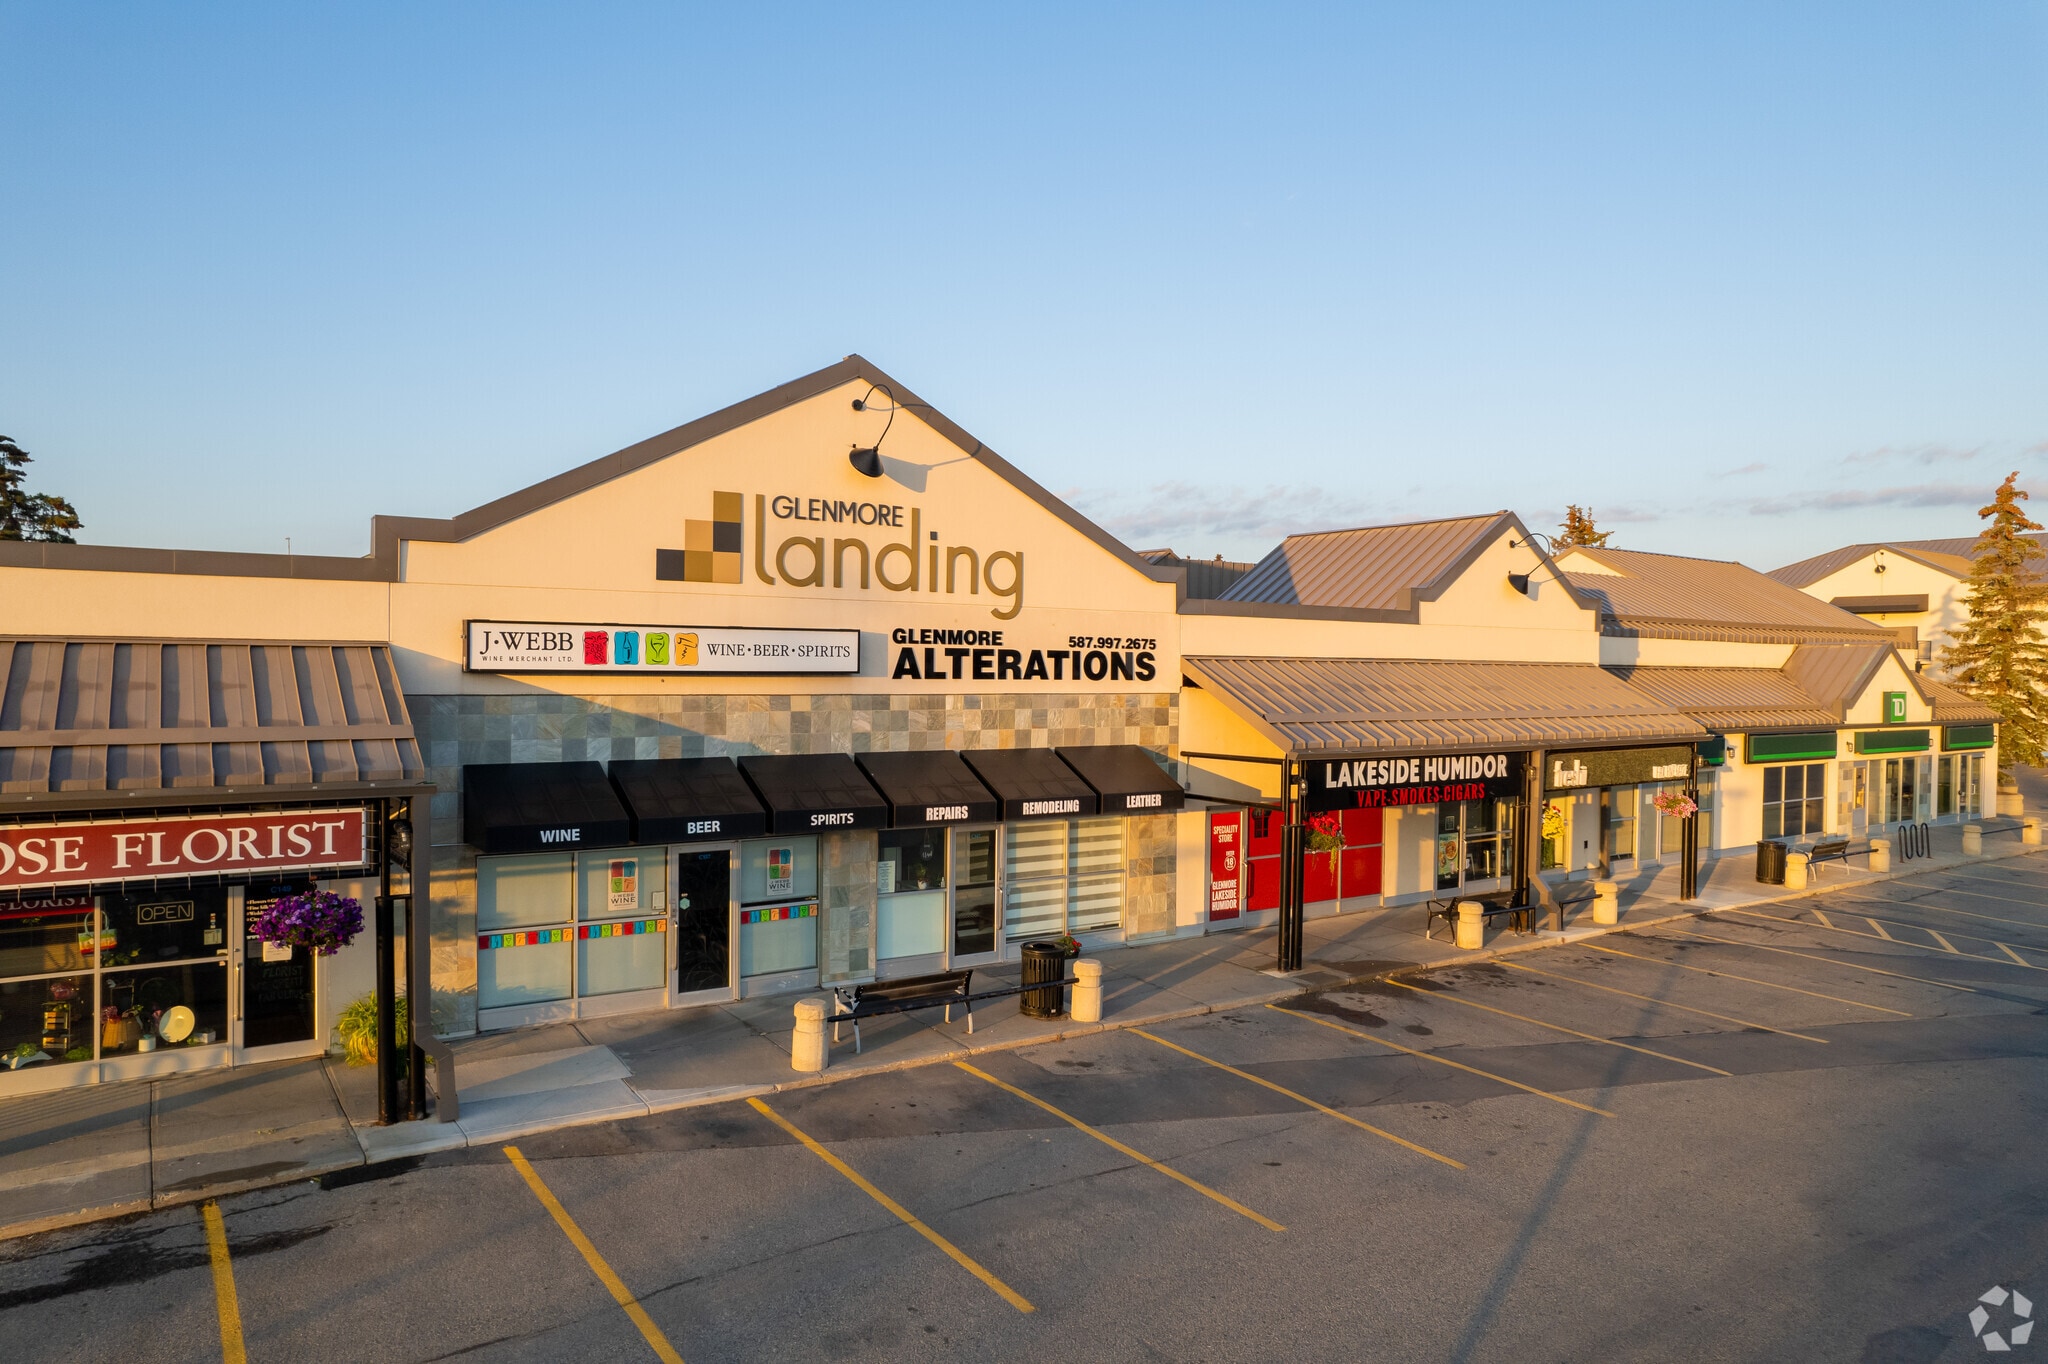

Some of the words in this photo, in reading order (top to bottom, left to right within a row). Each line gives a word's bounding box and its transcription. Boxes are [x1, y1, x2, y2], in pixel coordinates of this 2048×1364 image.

[771, 495, 904, 528] GLENMORE
[755, 493, 1024, 621] landing
[892, 628, 1003, 646] GLENMORE
[1068, 635, 1157, 650] 587.997.2675
[892, 646, 1157, 682] ALTERATIONS
[1892, 698, 1905, 717] TD
[1325, 758, 1420, 788] LAKESIDE
[1424, 754, 1508, 782] HUMIDOR
[1022, 799, 1080, 815] REMODELING
[1126, 794, 1162, 808] LEATHER
[810, 812, 854, 826] SPIRITS
[926, 805, 969, 821] REPAIRS
[687, 820, 721, 835] BEER
[540, 828, 581, 843] WINE
[1218, 833, 1233, 843] STORE
[111, 820, 345, 869] FLORIST
[1226, 857, 1234, 866] 18
[769, 882, 791, 890] WINE
[1212, 880, 1237, 890] GLENMORE
[610, 896, 636, 904] WINE
[1212, 889, 1237, 901] LAKESIDE
[141, 902, 191, 922] OPEN
[1212, 899, 1237, 911] HUMIDOR
